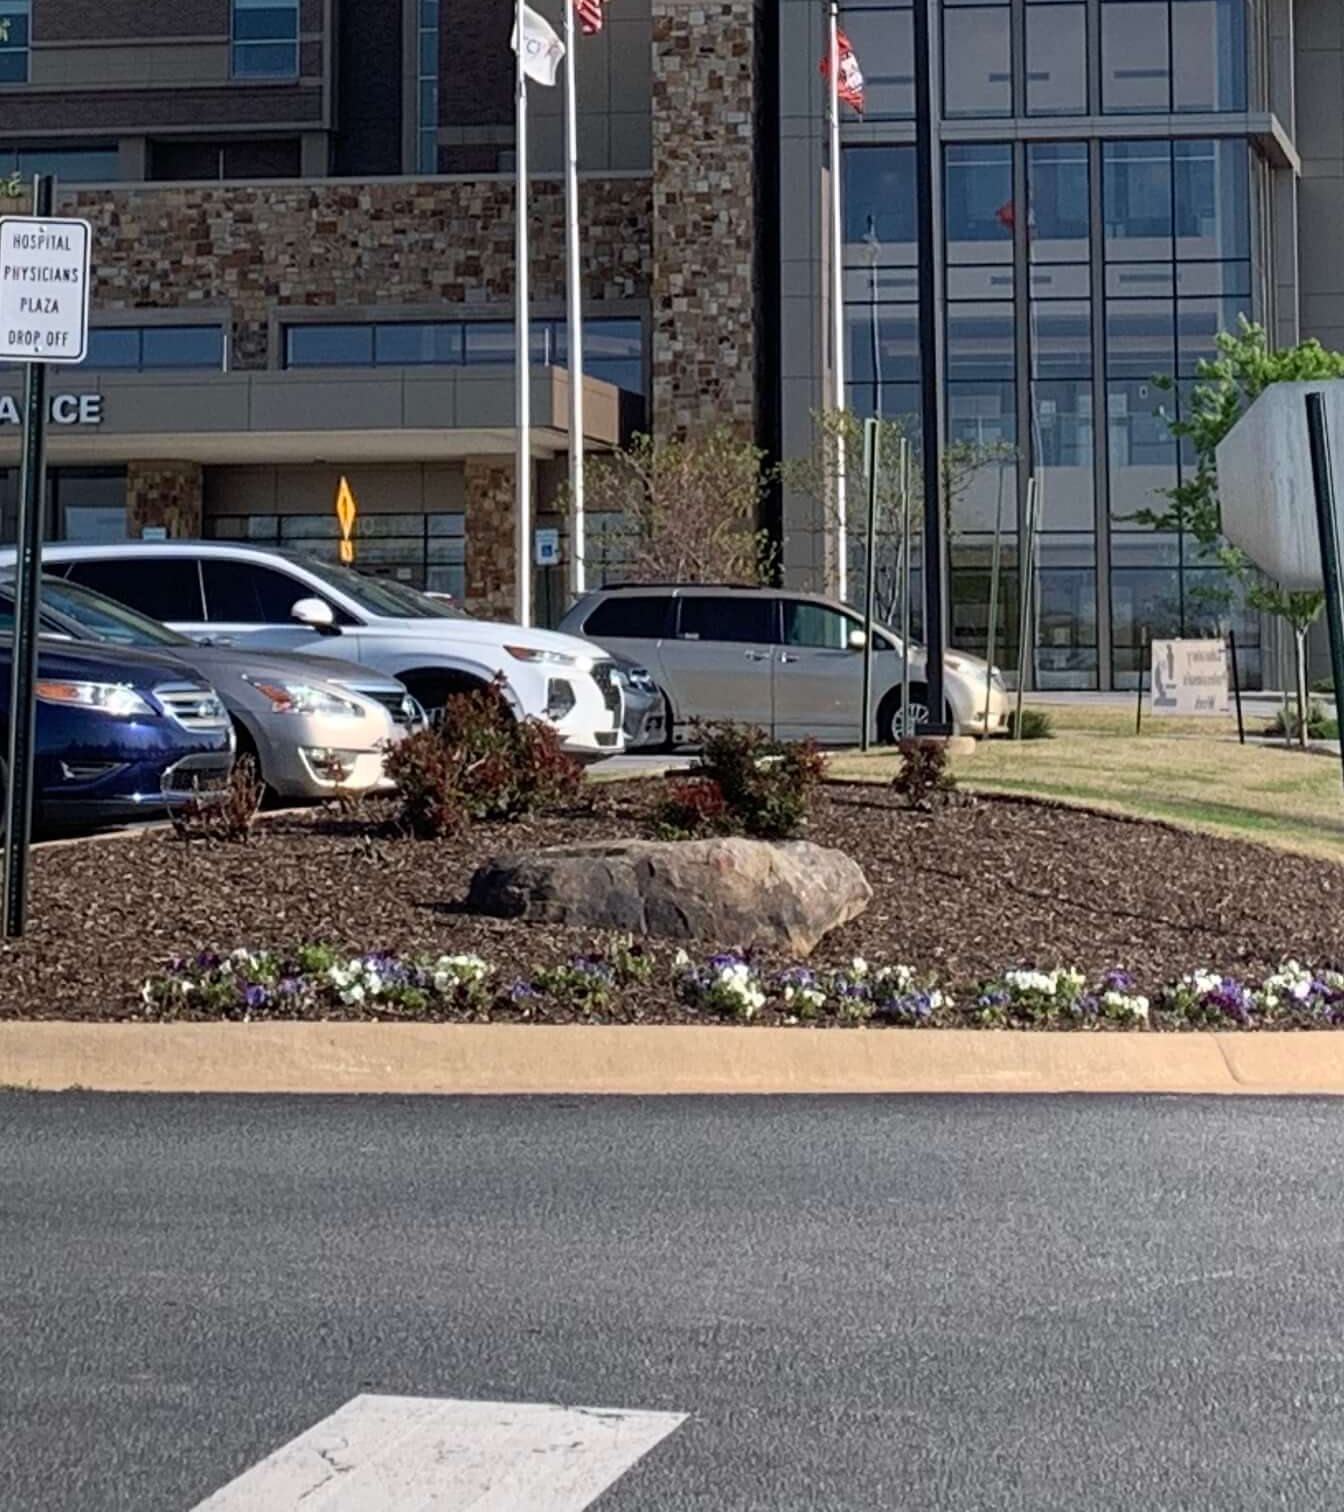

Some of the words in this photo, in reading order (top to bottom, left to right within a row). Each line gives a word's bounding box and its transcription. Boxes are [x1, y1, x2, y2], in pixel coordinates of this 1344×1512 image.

[13, 235, 71, 251] HOSPITAL
[4, 266, 78, 283] PHYSICIANS
[20, 297, 59, 314] PLAZA
[8, 330, 40, 346] DROP
[46, 331, 69, 347] OFF
